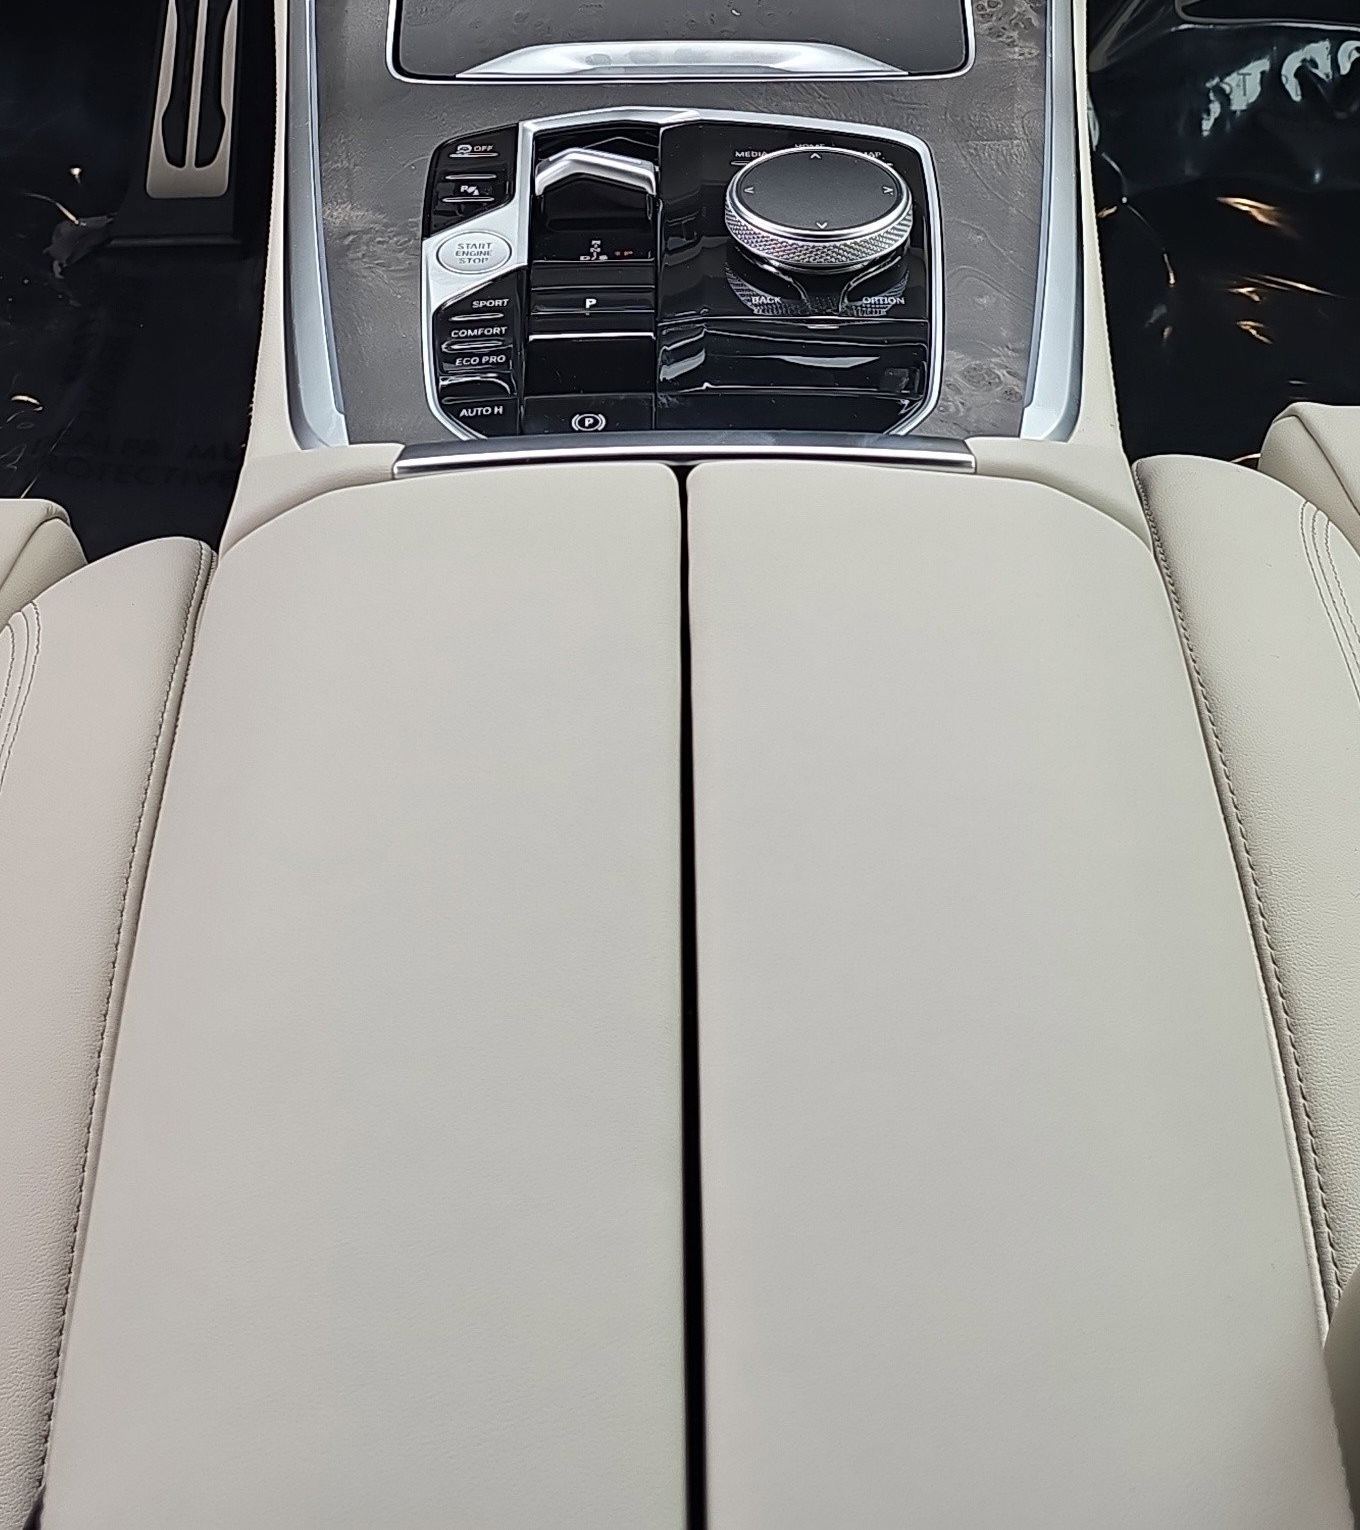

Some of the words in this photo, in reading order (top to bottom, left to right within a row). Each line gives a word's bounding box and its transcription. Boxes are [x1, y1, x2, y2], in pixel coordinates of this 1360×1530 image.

[734, 150, 769, 158] MEDIA
[457, 242, 492, 250] START
[472, 298, 509, 309] SPORT
[585, 298, 597, 309] P
[751, 296, 783, 304] BACK
[450, 326, 507, 338] COMFORT
[455, 356, 480, 366] ECO
[481, 354, 506, 364] PRO
[459, 406, 492, 418] AUTO
[494, 405, 504, 415] H
